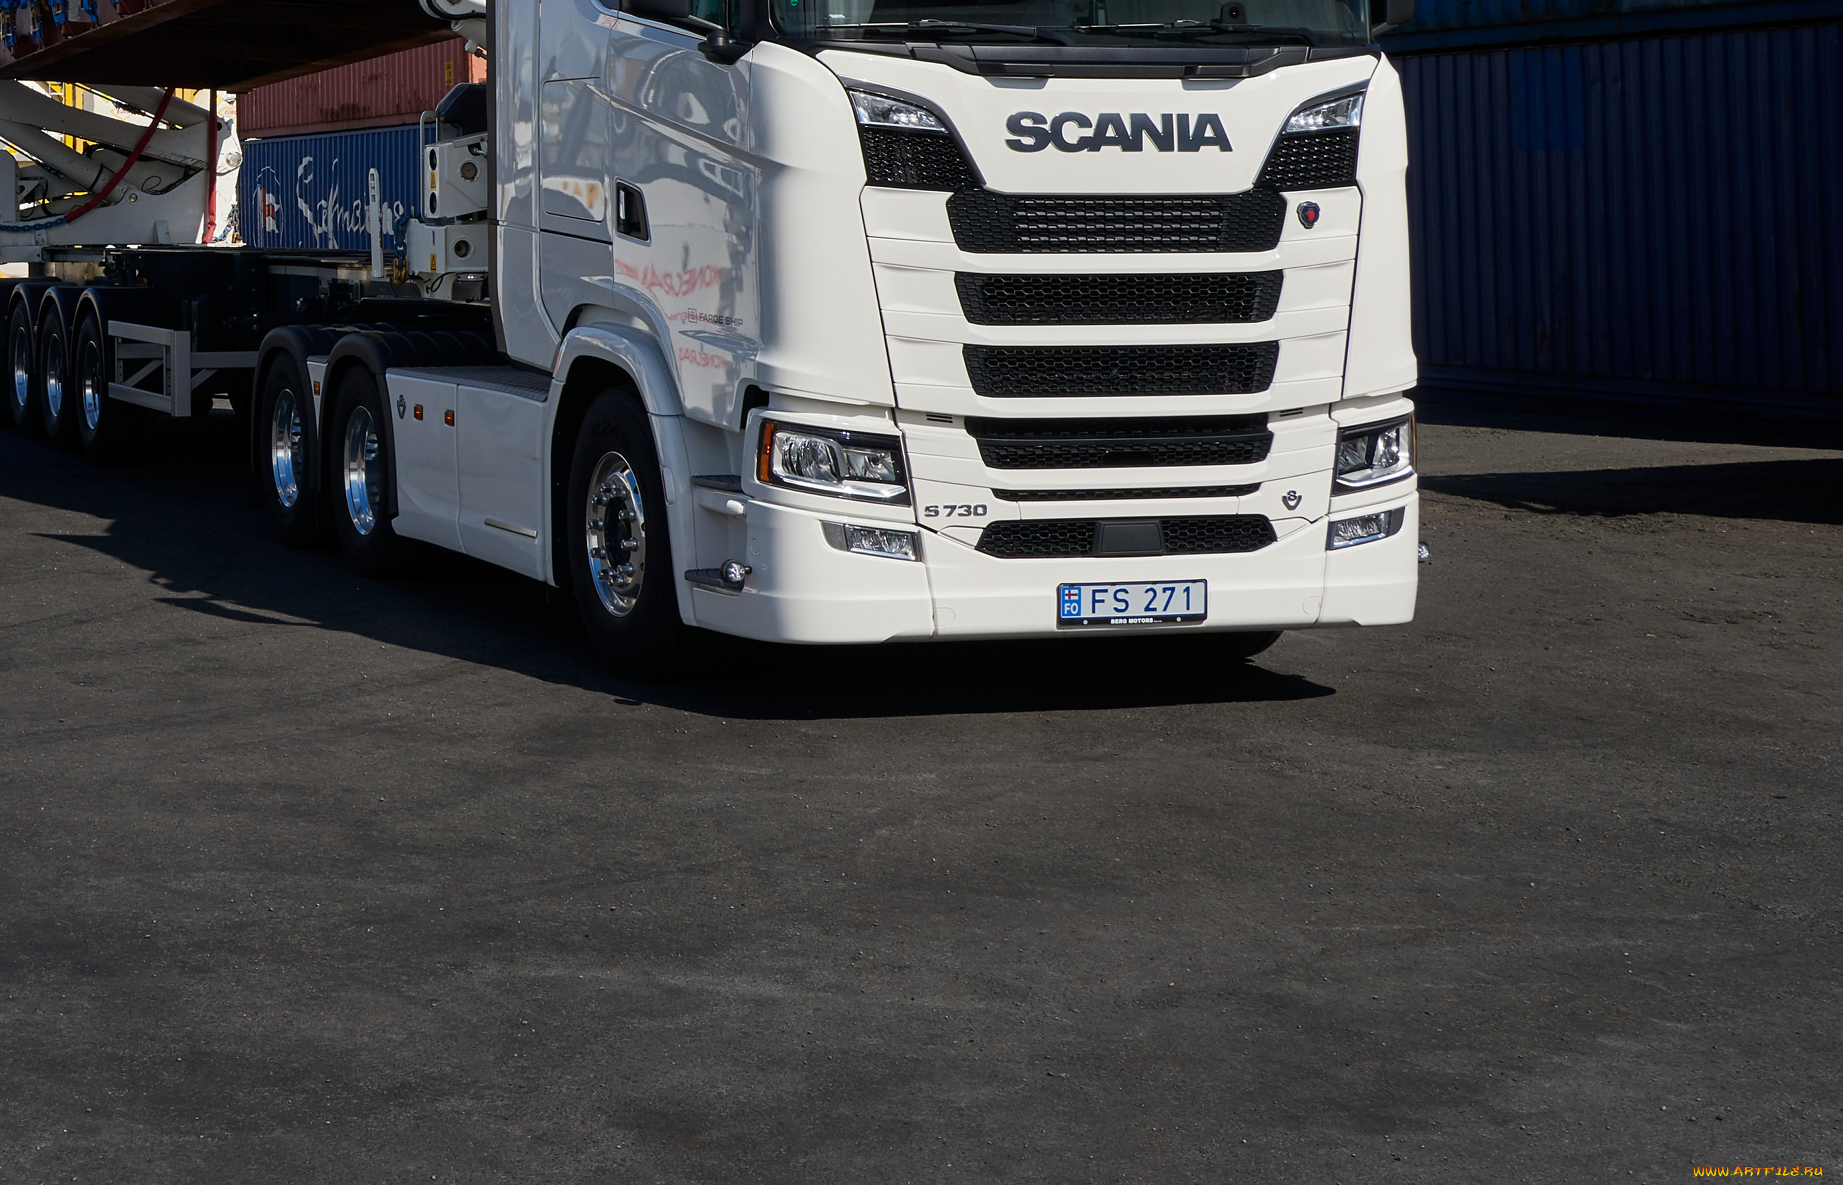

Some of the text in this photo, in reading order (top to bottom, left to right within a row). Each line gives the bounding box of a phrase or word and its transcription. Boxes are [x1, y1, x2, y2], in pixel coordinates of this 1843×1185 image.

[1004, 111, 1234, 153] SCANIA
[698, 312, 744, 327] FAROE SHIP
[923, 503, 988, 517] S 730
[1091, 585, 1191, 614] FS 271
[1064, 603, 1079, 615] FO
